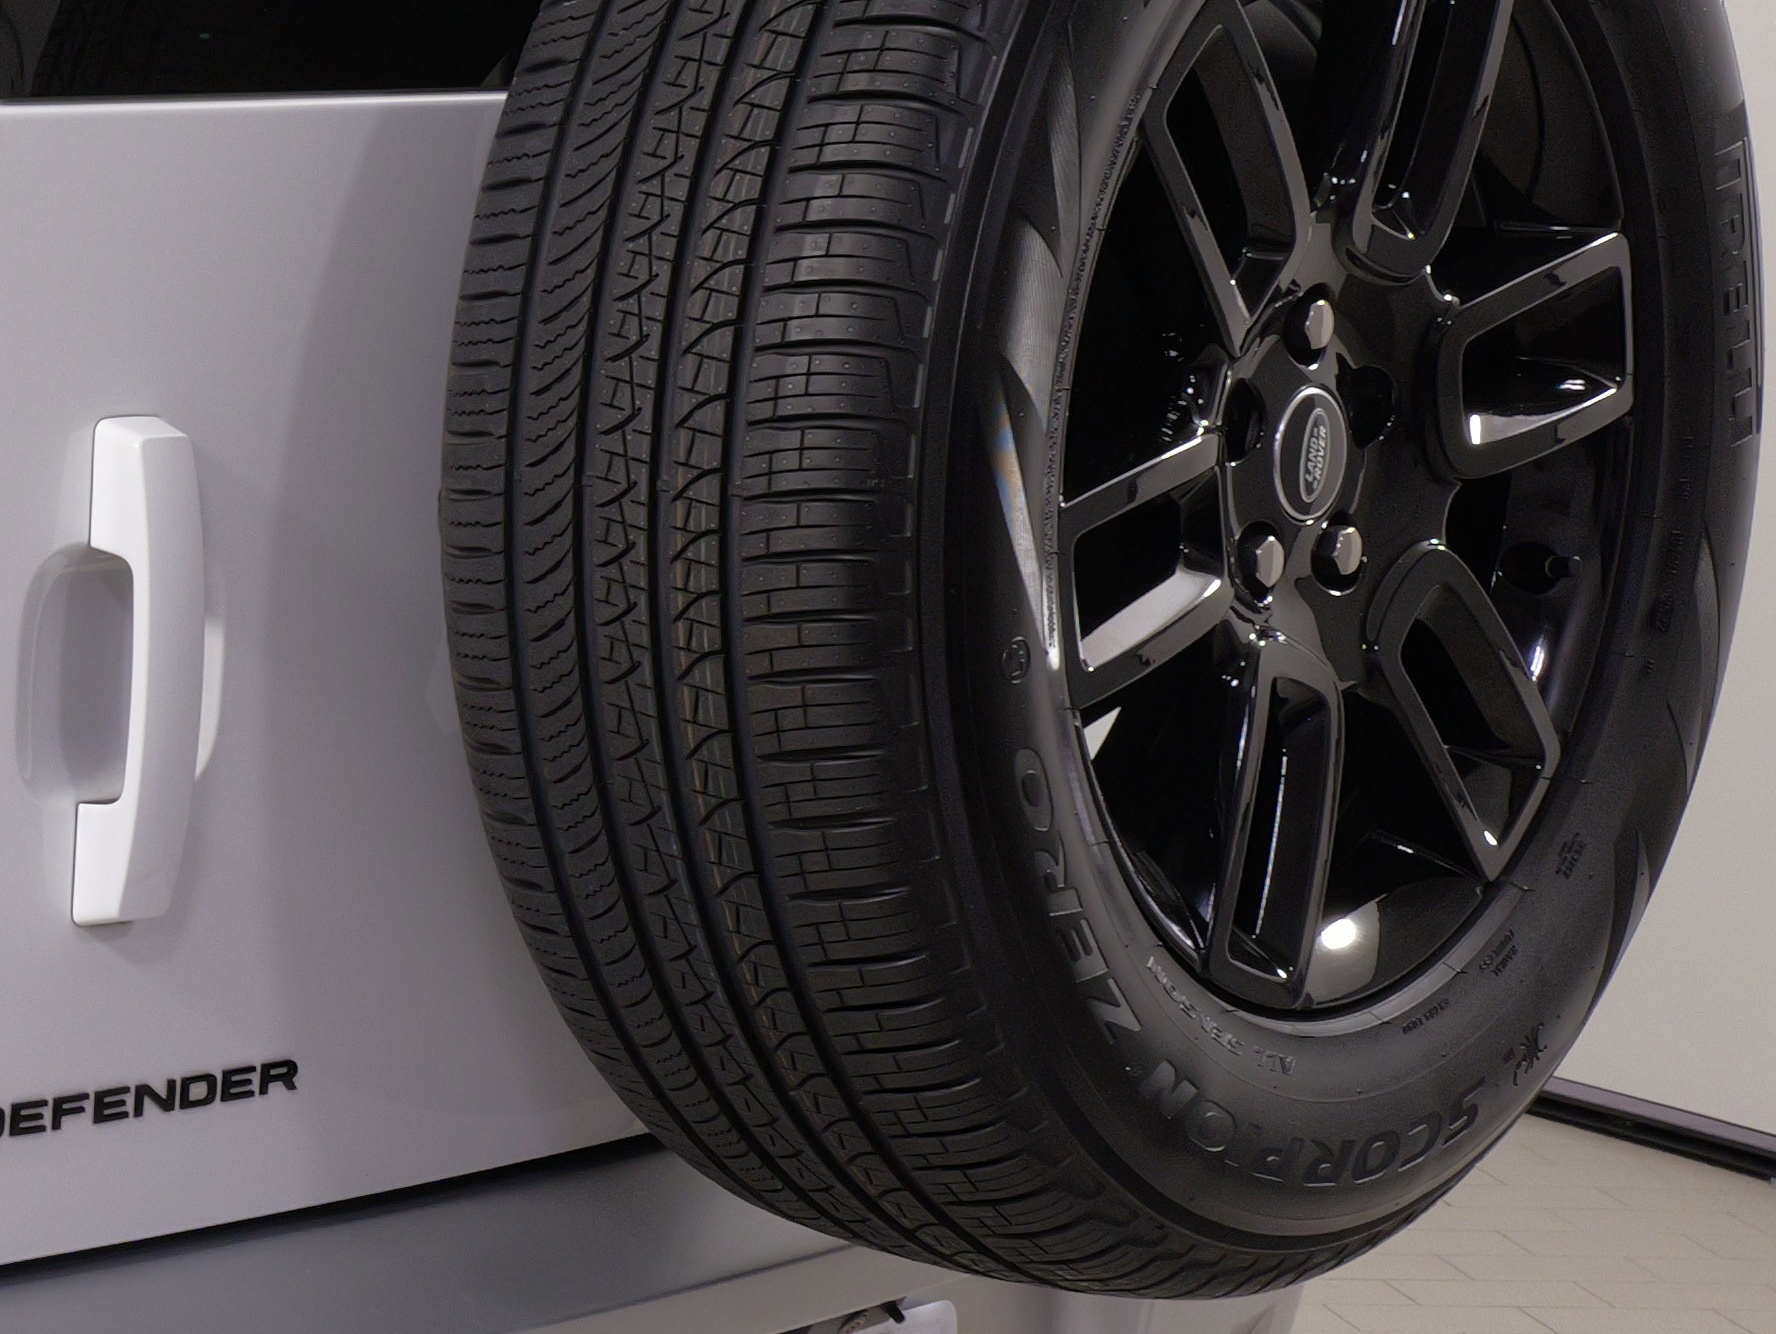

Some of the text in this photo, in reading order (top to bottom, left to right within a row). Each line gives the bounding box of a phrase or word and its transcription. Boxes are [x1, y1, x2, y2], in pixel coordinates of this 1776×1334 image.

[1305, 436, 1319, 483] LAND
[1313, 425, 1327, 481] ROVER
[1012, 746, 1487, 1188] SCORPION ZERO
[1147, 955, 1296, 1076] ALL SEASON
